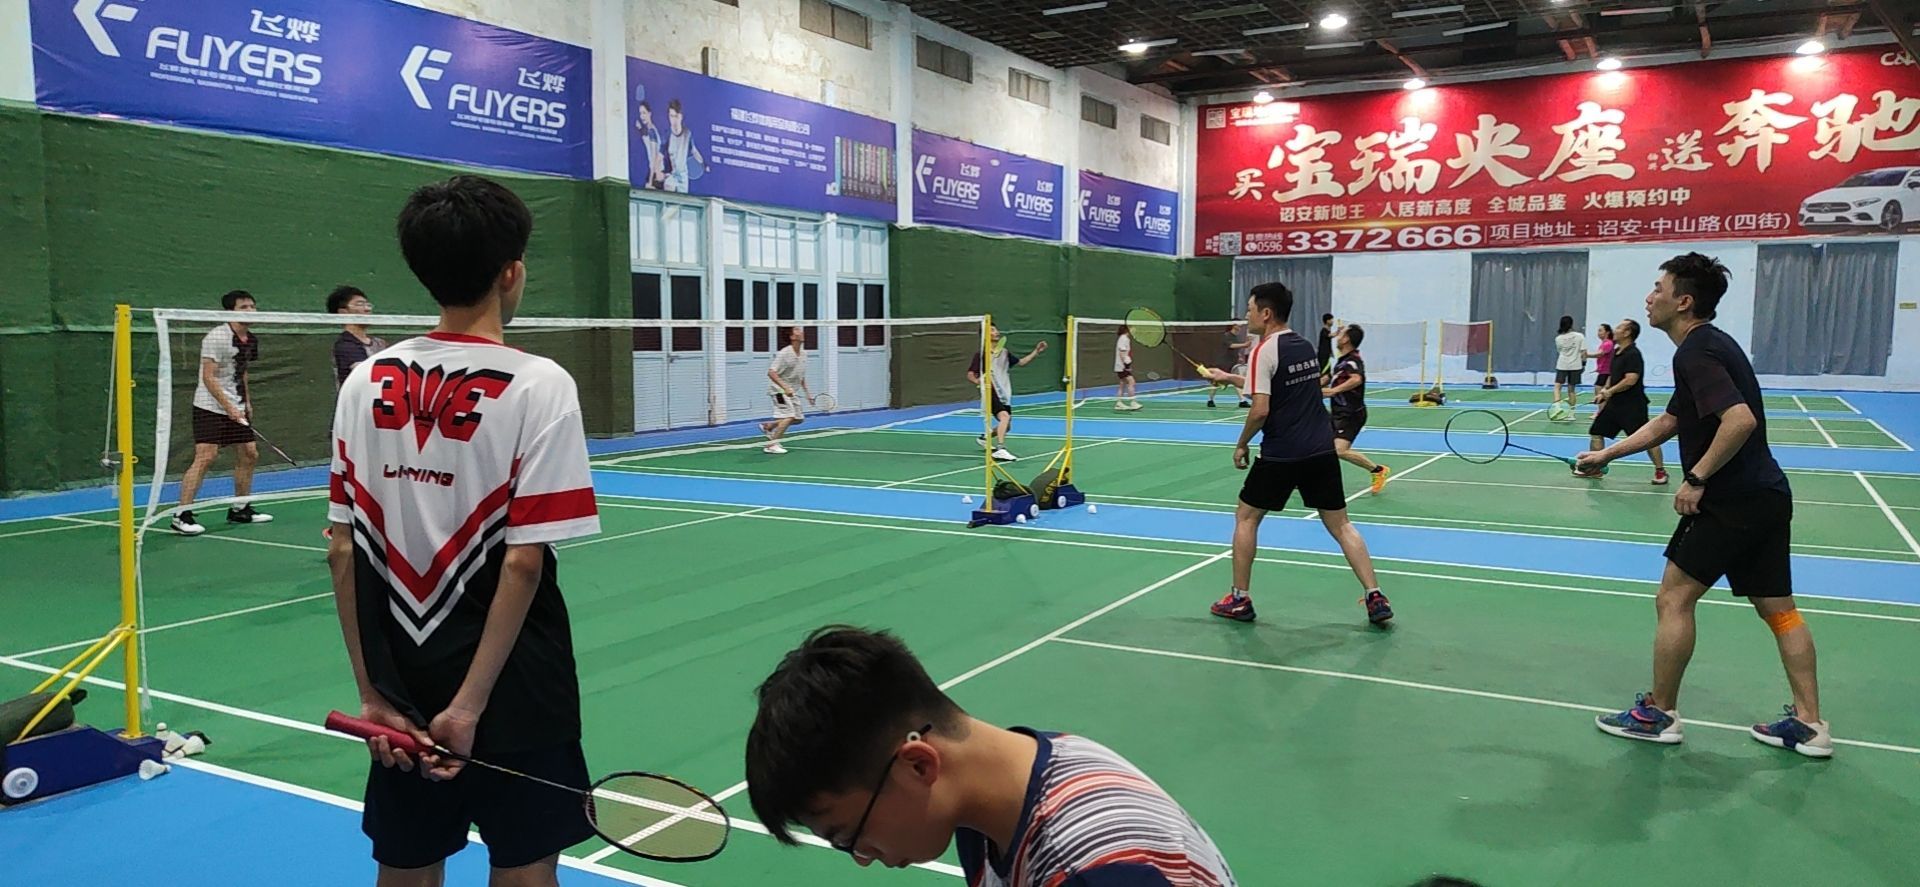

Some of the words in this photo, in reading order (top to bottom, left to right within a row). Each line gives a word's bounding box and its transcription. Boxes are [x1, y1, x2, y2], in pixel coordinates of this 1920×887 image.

[250, 9, 321, 43] 飞烨
[145, 26, 323, 87] FLIYERS
[447, 83, 567, 129] FLIYERS
[1279, 203, 1366, 223] 诏安新地王
[1379, 198, 1473, 218] 人居新高度
[1487, 193, 1567, 214] 全城品鉴
[1582, 187, 1691, 210] 火爆预约中
[1257, 241, 1283, 253] 0596
[1286, 224, 1482, 252] 3372666
